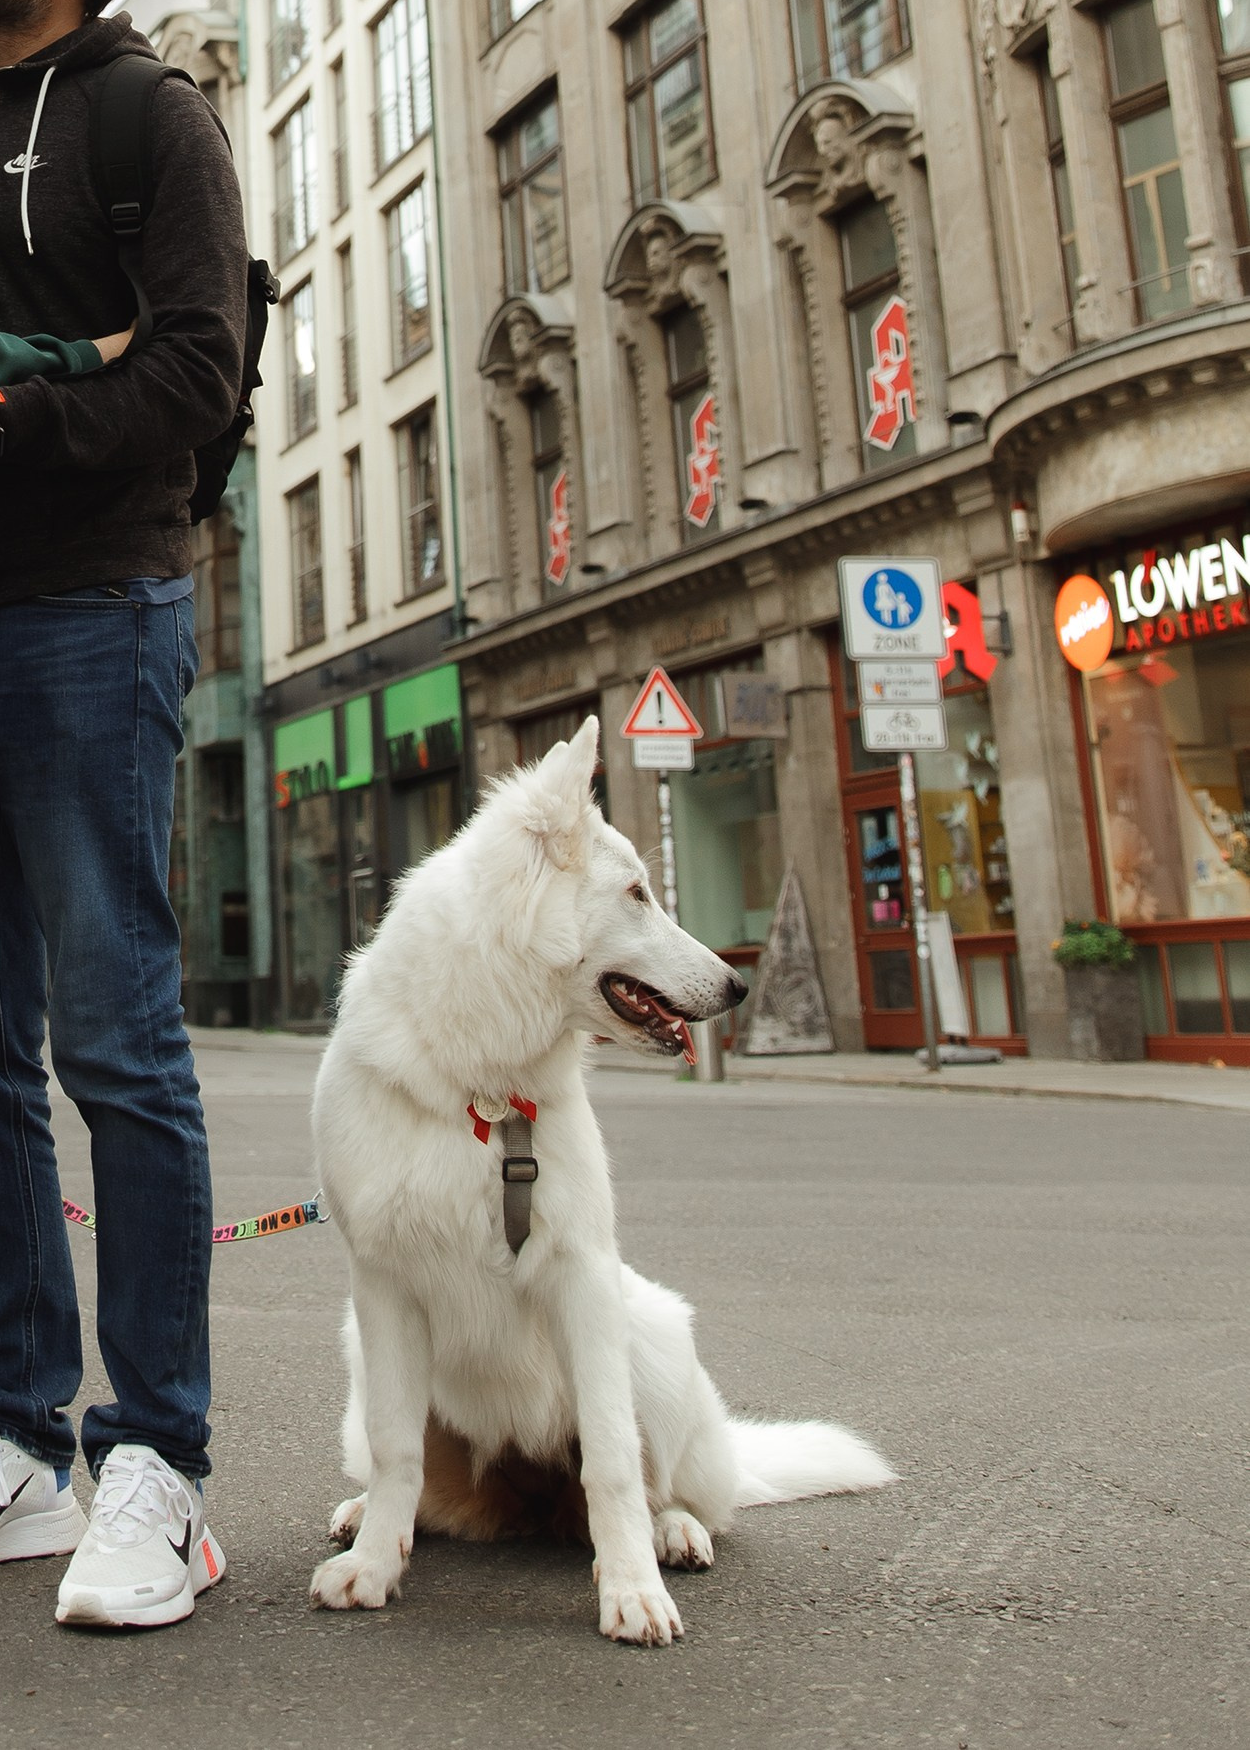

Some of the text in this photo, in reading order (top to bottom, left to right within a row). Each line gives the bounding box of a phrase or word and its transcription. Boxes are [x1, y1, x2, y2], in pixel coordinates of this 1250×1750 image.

[12, 153, 40, 167] NIE
[1126, 600, 1250, 652] APOTHEK
[873, 633, 921, 652] ZONE
